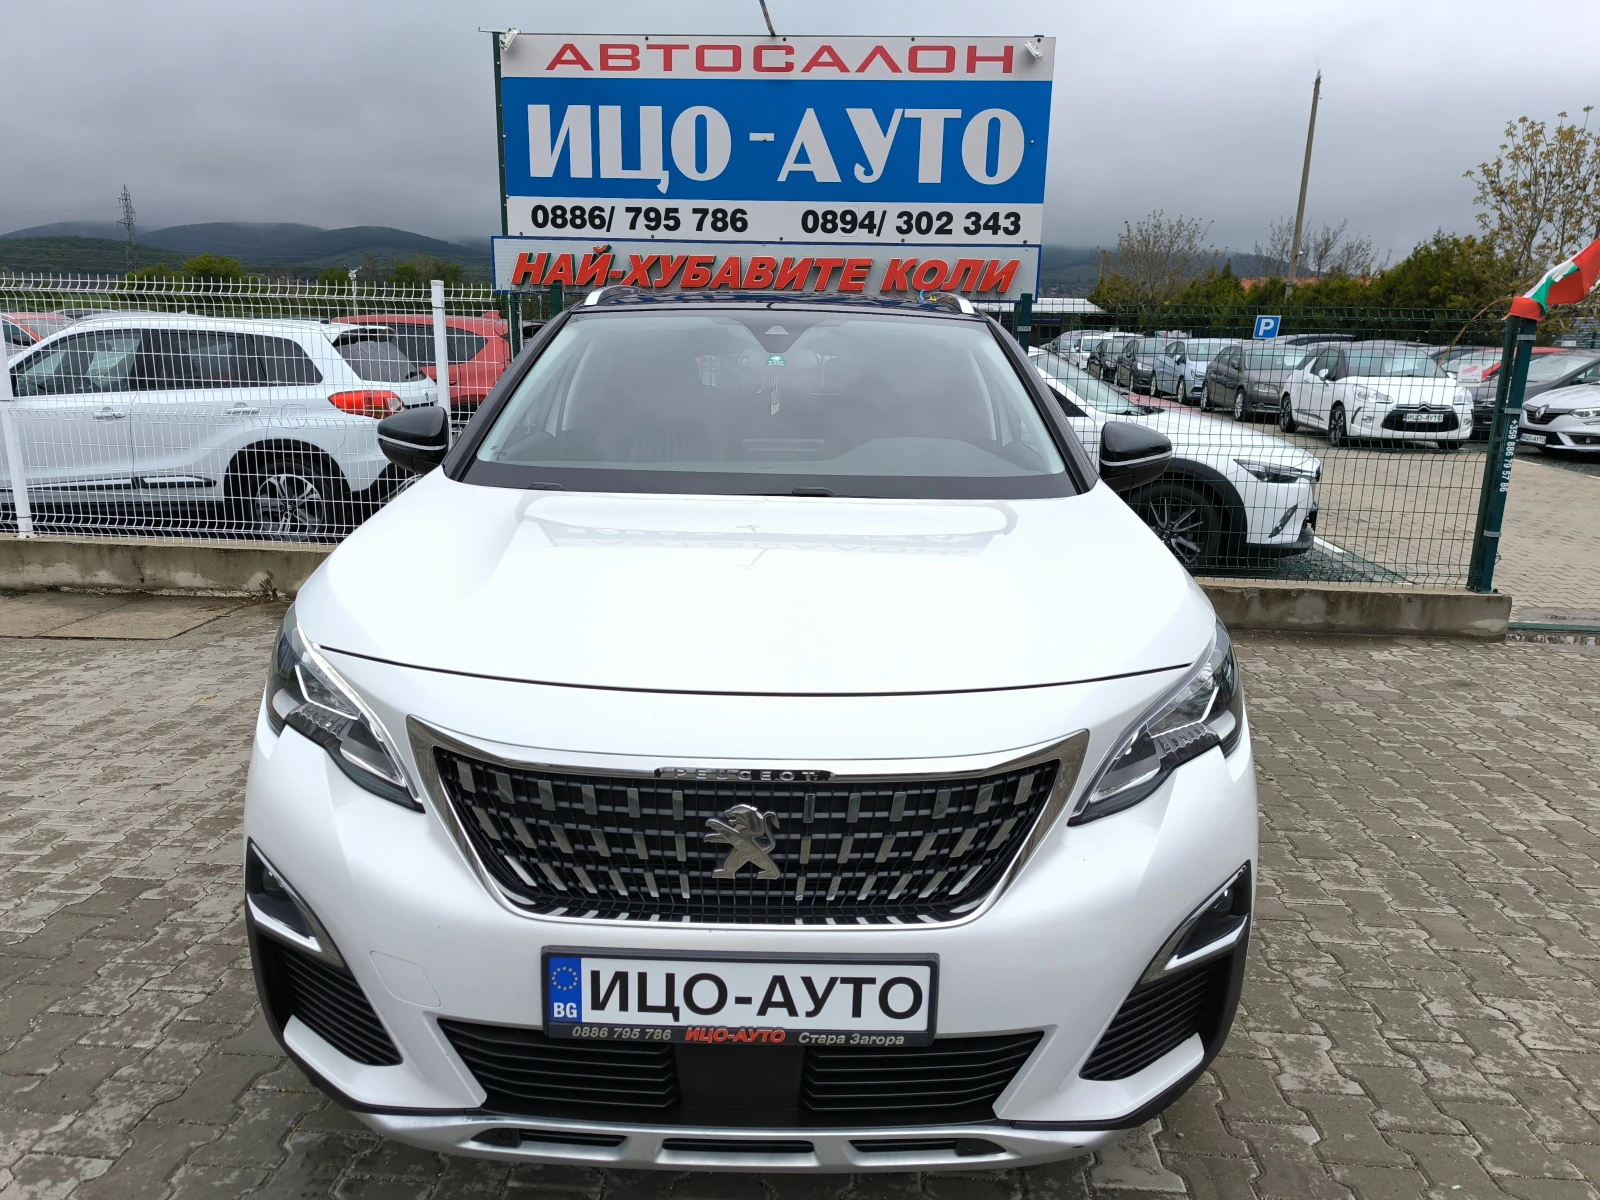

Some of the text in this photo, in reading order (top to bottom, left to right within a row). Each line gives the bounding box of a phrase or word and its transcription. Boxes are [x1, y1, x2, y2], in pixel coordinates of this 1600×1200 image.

[545, 43, 1014, 74] АВТОСАЛОН
[625, 207, 682, 232] 795
[692, 207, 749, 234] 786
[895, 210, 959, 237] 302
[963, 211, 1022, 237] 343
[511, 245, 1023, 294] НАЙ-ХУБАВИТЕ КОЛИ
[1258, 318, 1275, 336] P
[1499, 419, 1519, 492] +359 886 79 57 86
[673, 768, 815, 781] PEUGEOT
[590, 970, 924, 1022] ИЦО-АУТО
[553, 1002, 579, 1019] BG
[572, 1026, 672, 1041] 0886 795 786
[684, 1025, 786, 1045] ИЦО-АУТО
[798, 1032, 905, 1047] Стара Загора
